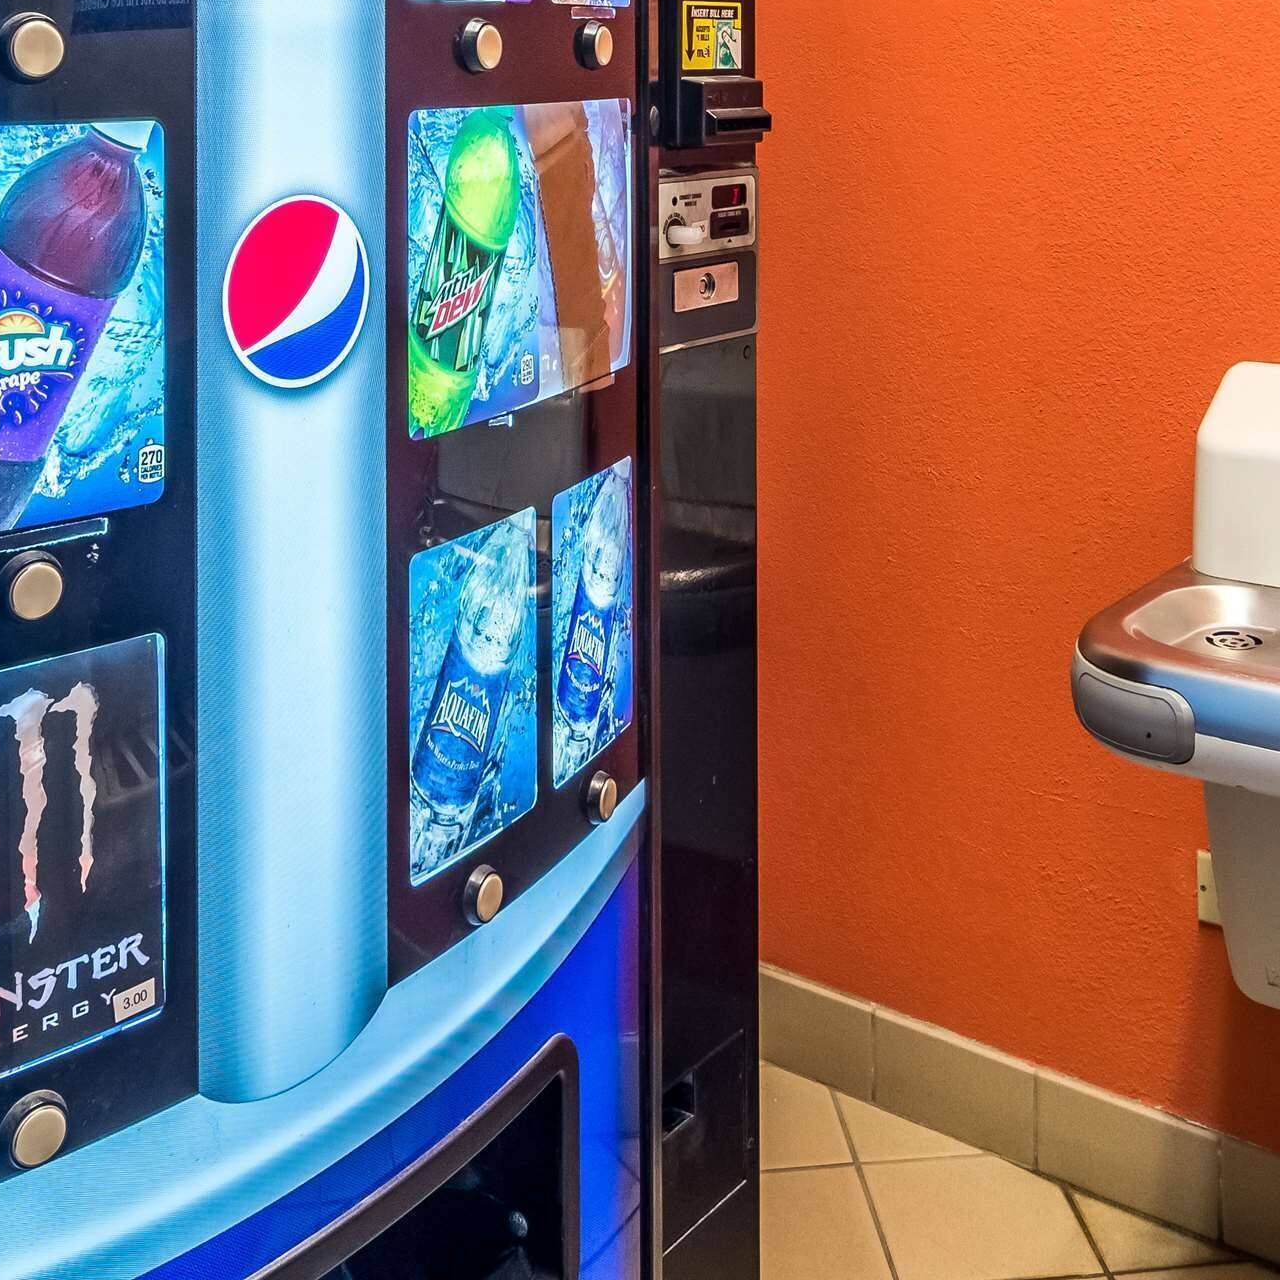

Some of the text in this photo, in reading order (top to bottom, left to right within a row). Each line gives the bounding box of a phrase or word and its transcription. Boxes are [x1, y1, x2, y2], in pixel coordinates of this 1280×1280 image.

[710, 8, 720, 18] BILL
[140, 450, 162, 466] 270
[140, 464, 162, 474] CALORIES
[431, 679, 490, 753] AQUAFINA
[122, 988, 148, 1010] 3.00
